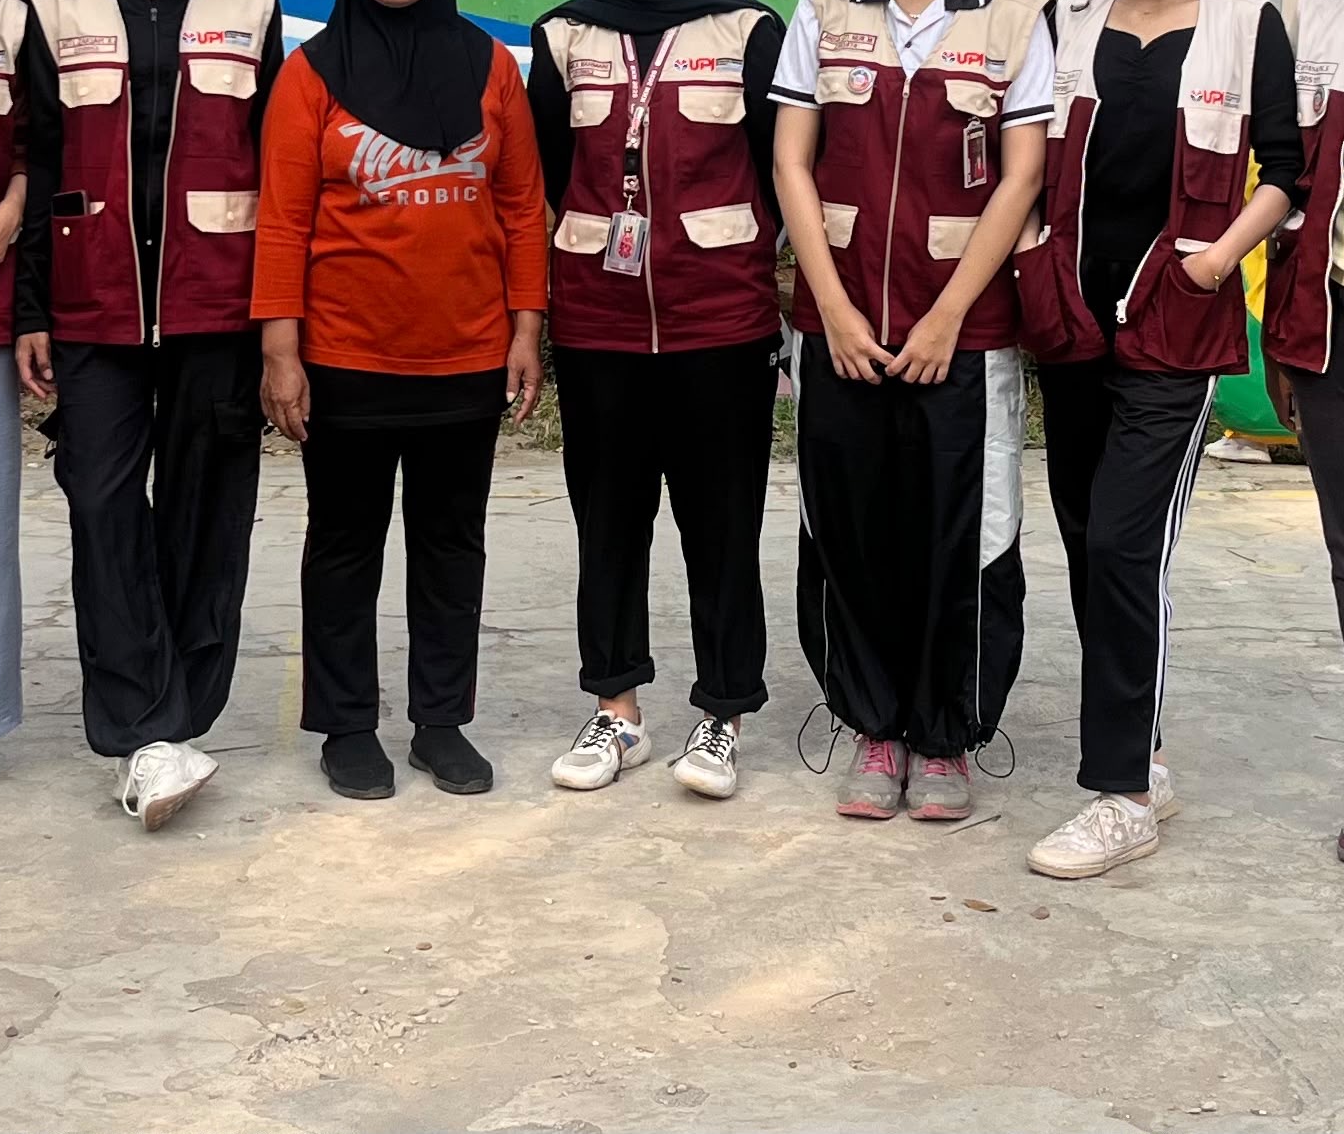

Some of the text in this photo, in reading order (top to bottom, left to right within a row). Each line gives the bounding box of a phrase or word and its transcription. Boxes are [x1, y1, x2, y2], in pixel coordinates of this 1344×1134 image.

[196, 31, 224, 44] UPI
[689, 57, 716, 72] UPI
[957, 52, 985, 65] UPI
[1203, 90, 1225, 105] UPI
[359, 186, 478, 205] AEROBIC
